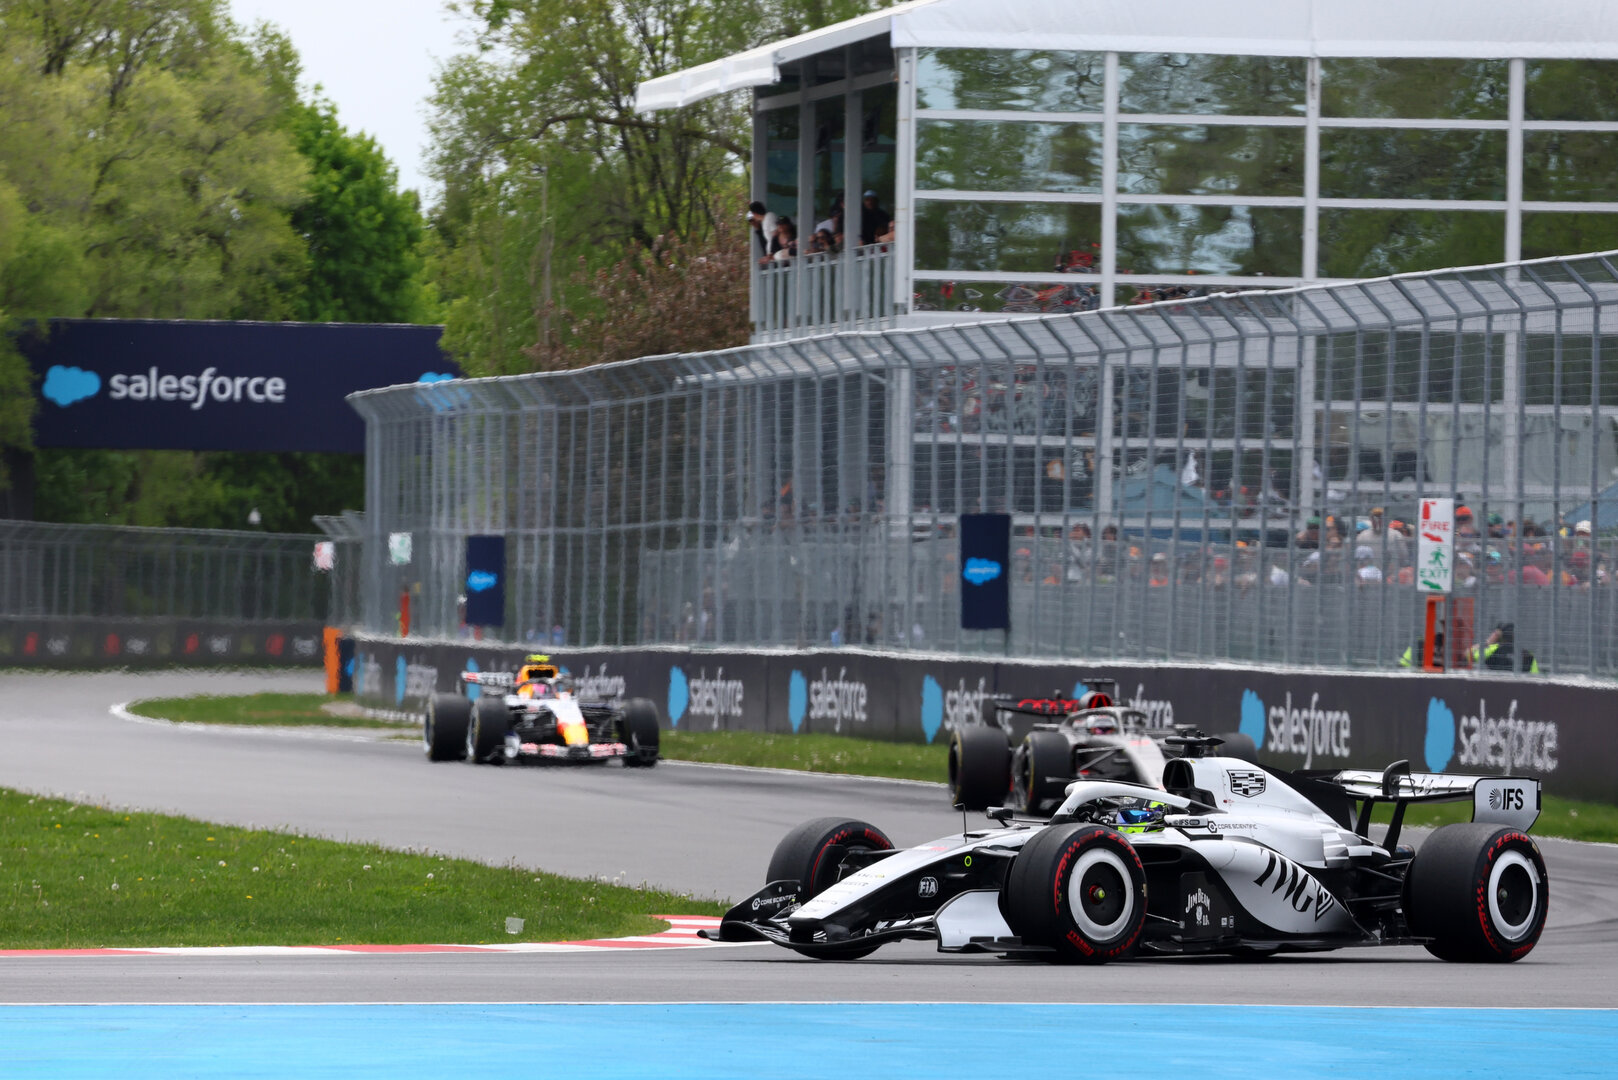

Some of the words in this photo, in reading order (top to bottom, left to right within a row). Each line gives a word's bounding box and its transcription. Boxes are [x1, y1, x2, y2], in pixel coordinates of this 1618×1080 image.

[109, 366, 287, 410] salesforce
[1421, 520, 1450, 532] FIRE
[1419, 567, 1449, 578] EXIT
[689, 666, 744, 730] salesforce
[810, 666, 868, 733] salesforce
[1268, 692, 1351, 770] salesforce
[1459, 698, 1558, 776] salesforce
[1502, 788, 1524, 811] IFS
[1495, 832, 1529, 849] ZERO
[919, 880, 937, 894] FIA
[760, 898, 773, 906] CORE
[772, 893, 797, 904] SCIENTIFIC
[1185, 892, 1198, 913] JIM
